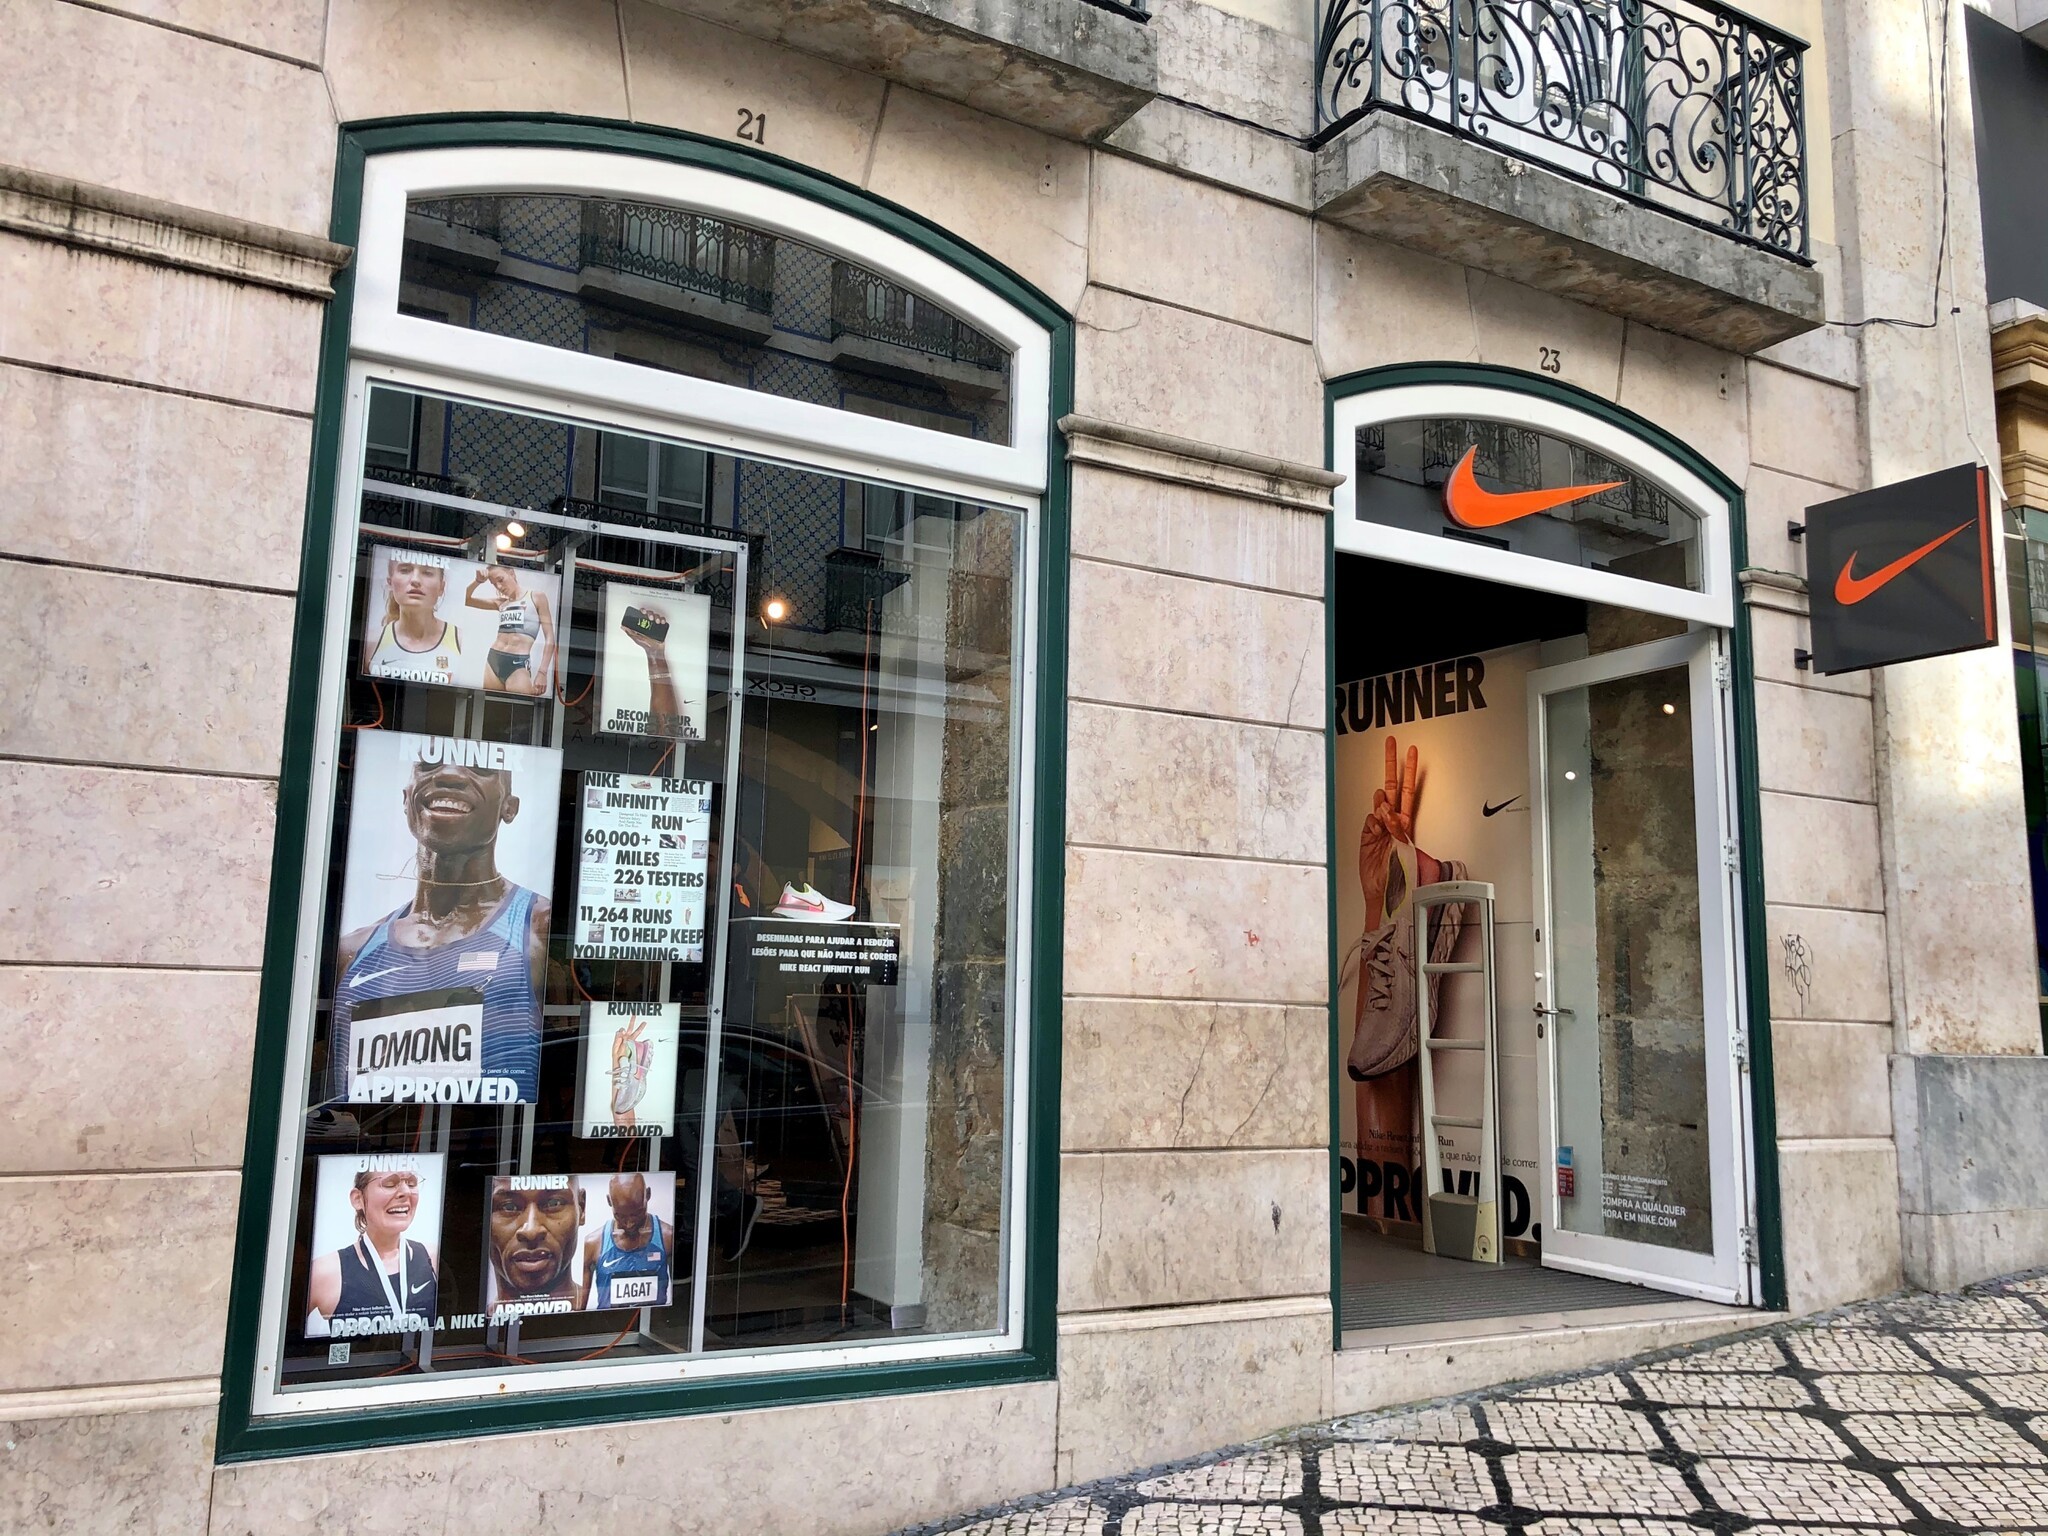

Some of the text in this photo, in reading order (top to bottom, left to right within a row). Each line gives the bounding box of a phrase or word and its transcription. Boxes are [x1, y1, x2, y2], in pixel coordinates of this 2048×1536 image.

[736, 108, 766, 145] 21
[1539, 346, 1561, 373] 23
[391, 548, 451, 570] RUNNER
[1335, 655, 1488, 736] RUNNER
[607, 719, 634, 733] OWN
[585, 771, 706, 795] NIKE REACT
[606, 792, 670, 811] INFINITY
[651, 815, 683, 831] RUN
[584, 829, 651, 848] 60,000+
[615, 850, 660, 867] MILES
[613, 869, 645, 885] 226
[647, 871, 704, 887] TESTERS
[580, 906, 673, 924] 11,264 RUNS
[610, 927, 704, 944] TO HELP KEEP
[756, 933, 895, 947] DESENHADAS PARA AJUDAR A REDUZIR
[574, 944, 684, 961] YOU RUNNING.
[752, 947, 898, 961] LESÕES PARA QUE NÃO PARES DE CORRER
[779, 963, 870, 974] NIKE REACT INFINITY RUN
[607, 1001, 663, 1017] RUNNER
[356, 1022, 473, 1076] LOMONG
[348, 1075, 527, 1104] APPROVED.
[1437, 1135, 1454, 1147] Run
[1446, 1152, 1460, 1162] que
[1461, 1152, 1477, 1163] não
[1512, 1158, 1538, 1169] correr.
[510, 1175, 569, 1191] RUNNER
[1600, 1195, 1687, 1216] COMPRA A QUALQUER
[1601, 1208, 1678, 1228] HORA EM NIKE.COM
[616, 1281, 653, 1299] LAGAT
[434, 1315, 446, 1331] A
[450, 1313, 485, 1330] NIKE
[489, 1312, 524, 1328] APP.
